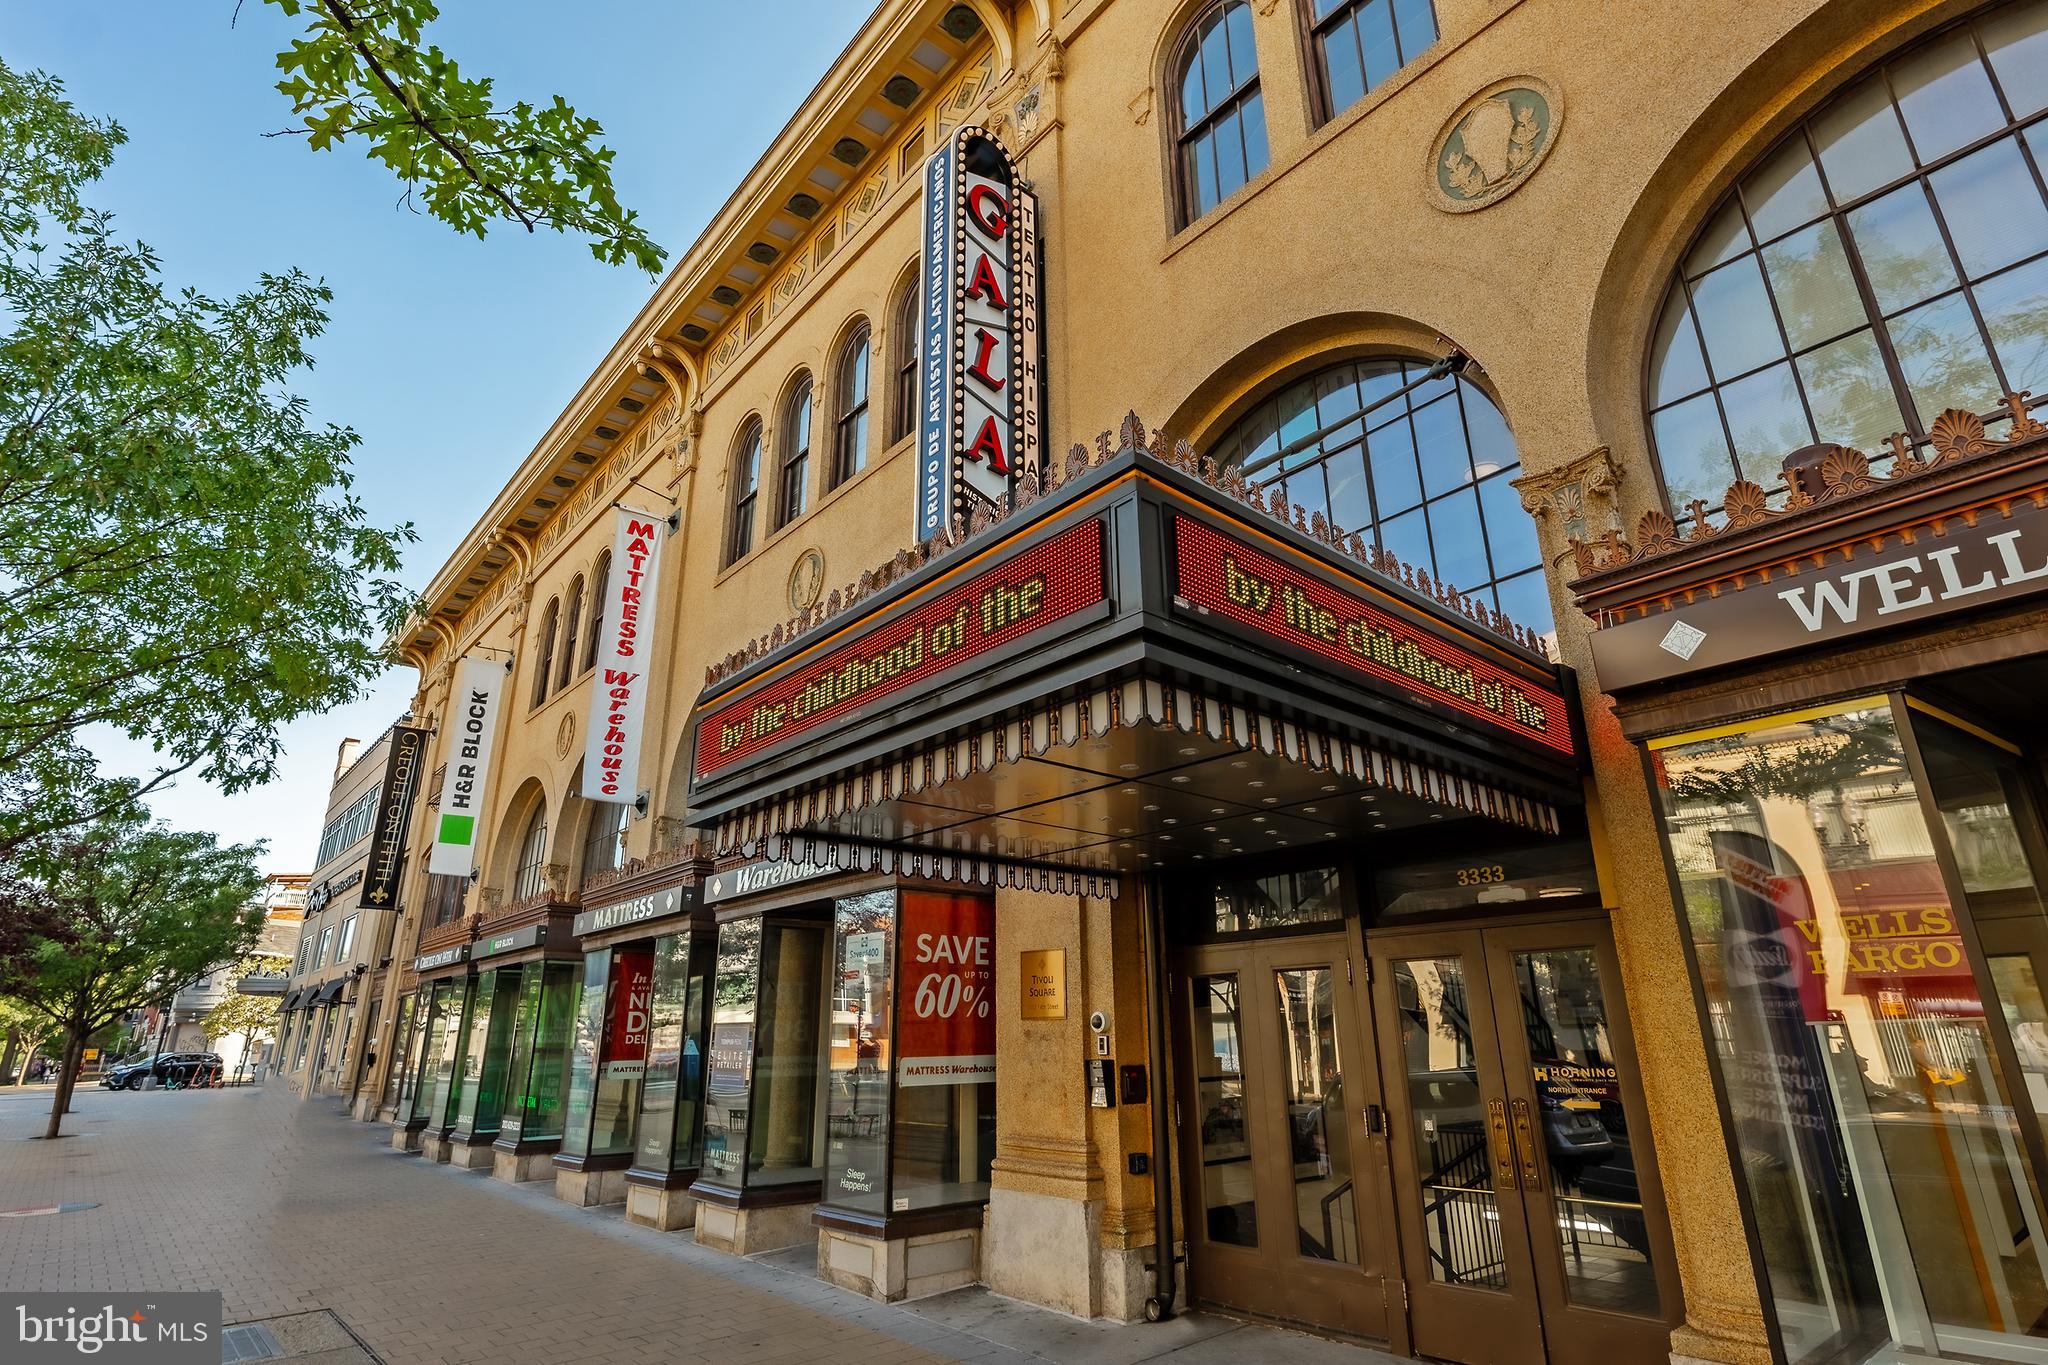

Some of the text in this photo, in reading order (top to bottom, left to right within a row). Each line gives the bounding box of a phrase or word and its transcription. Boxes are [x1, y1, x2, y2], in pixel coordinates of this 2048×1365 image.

[1022, 205, 1037, 334] TEATRO
[926, 156, 945, 530] GRUPO DE ARTISTAS LATINOAMERICANOS
[965, 183, 1011, 477] GALA
[963, 486, 999, 517] HISTRIC
[617, 519, 655, 658] MATTRESS
[1225, 555, 1547, 731] by the childhood of the
[719, 577, 1044, 754] by the childhood of the
[601, 668, 640, 796] Warehouse
[453, 689, 490, 809] H&R BLOCK
[390, 731, 419, 800] CREOLE
[384, 804, 403, 833] ON
[1457, 865, 1505, 886] 3333
[592, 895, 655, 931] MATTRESS
[1793, 906, 1952, 944] WELLS
[916, 933, 990, 966] SAVE
[1806, 940, 1961, 975] FARGO
[632, 972, 648, 984] In
[964, 971, 989, 979] UP TO
[1031, 975, 1054, 984] TIVOLI
[914, 972, 989, 1019] 60%
[1029, 987, 1056, 998] SQUARE
[716, 1061, 742, 1070] RETAILER
[717, 1051, 743, 1061] ELITE
[906, 1065, 950, 1076] MATTRESS
[1550, 1067, 1616, 1079] HORNING
[1571, 1087, 1607, 1095] ENTRANCE
[710, 1148, 740, 1164] MATTRESS
[840, 1178, 872, 1193] Happens!
[846, 1168, 866, 1182] Sleep
